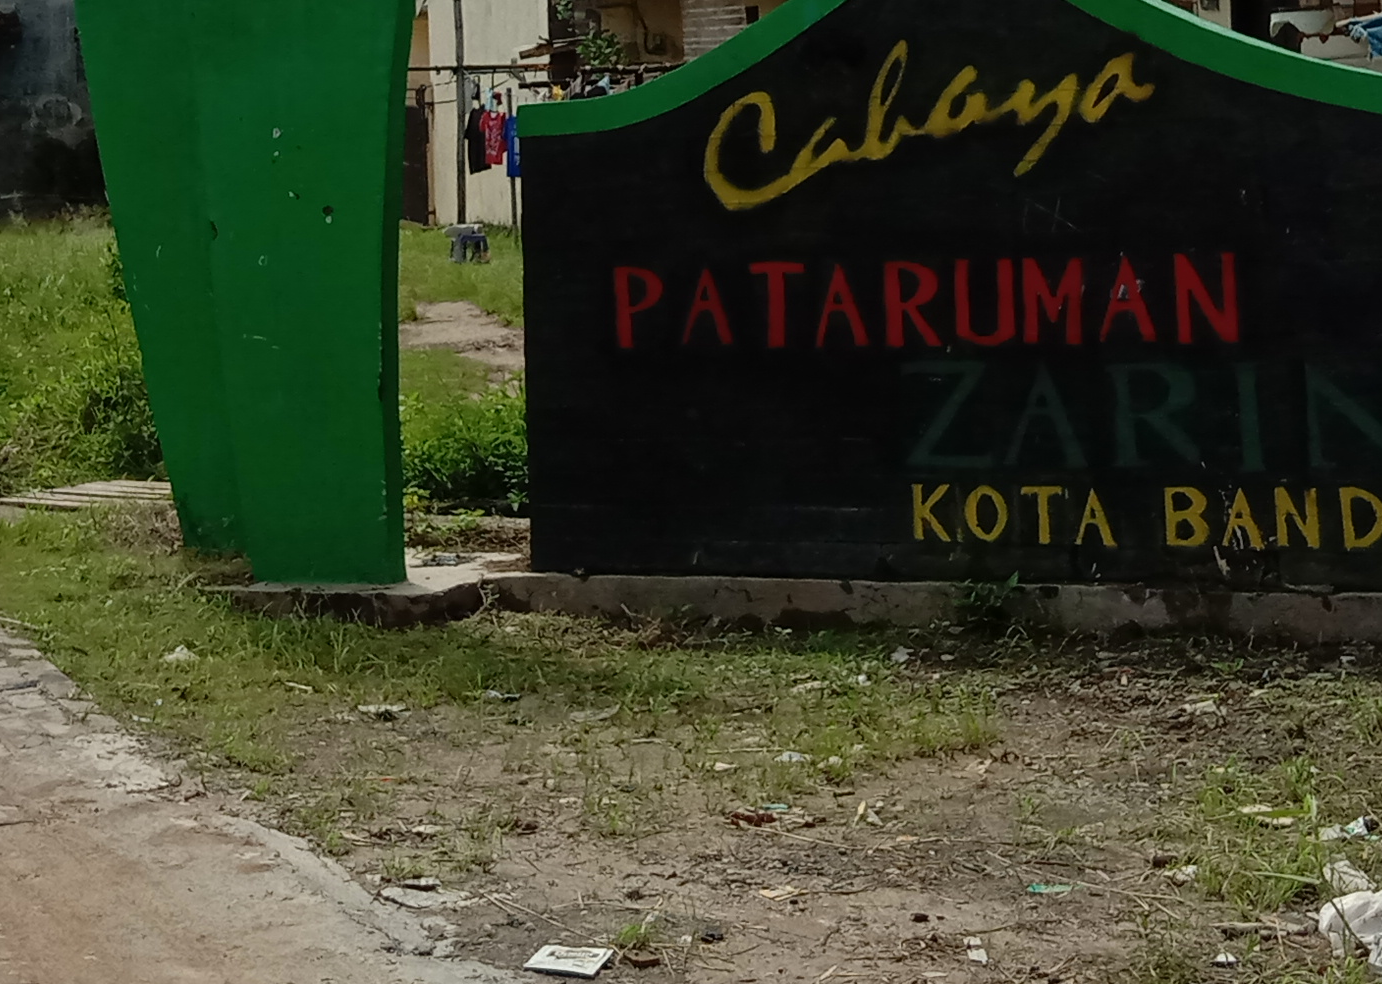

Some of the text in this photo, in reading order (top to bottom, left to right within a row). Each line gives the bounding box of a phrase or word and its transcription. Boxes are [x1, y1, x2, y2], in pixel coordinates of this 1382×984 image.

[704, 39, 1155, 211] Cahaya
[613, 251, 1240, 348] PATARUMAN
[910, 483, 1117, 547] KOTA
